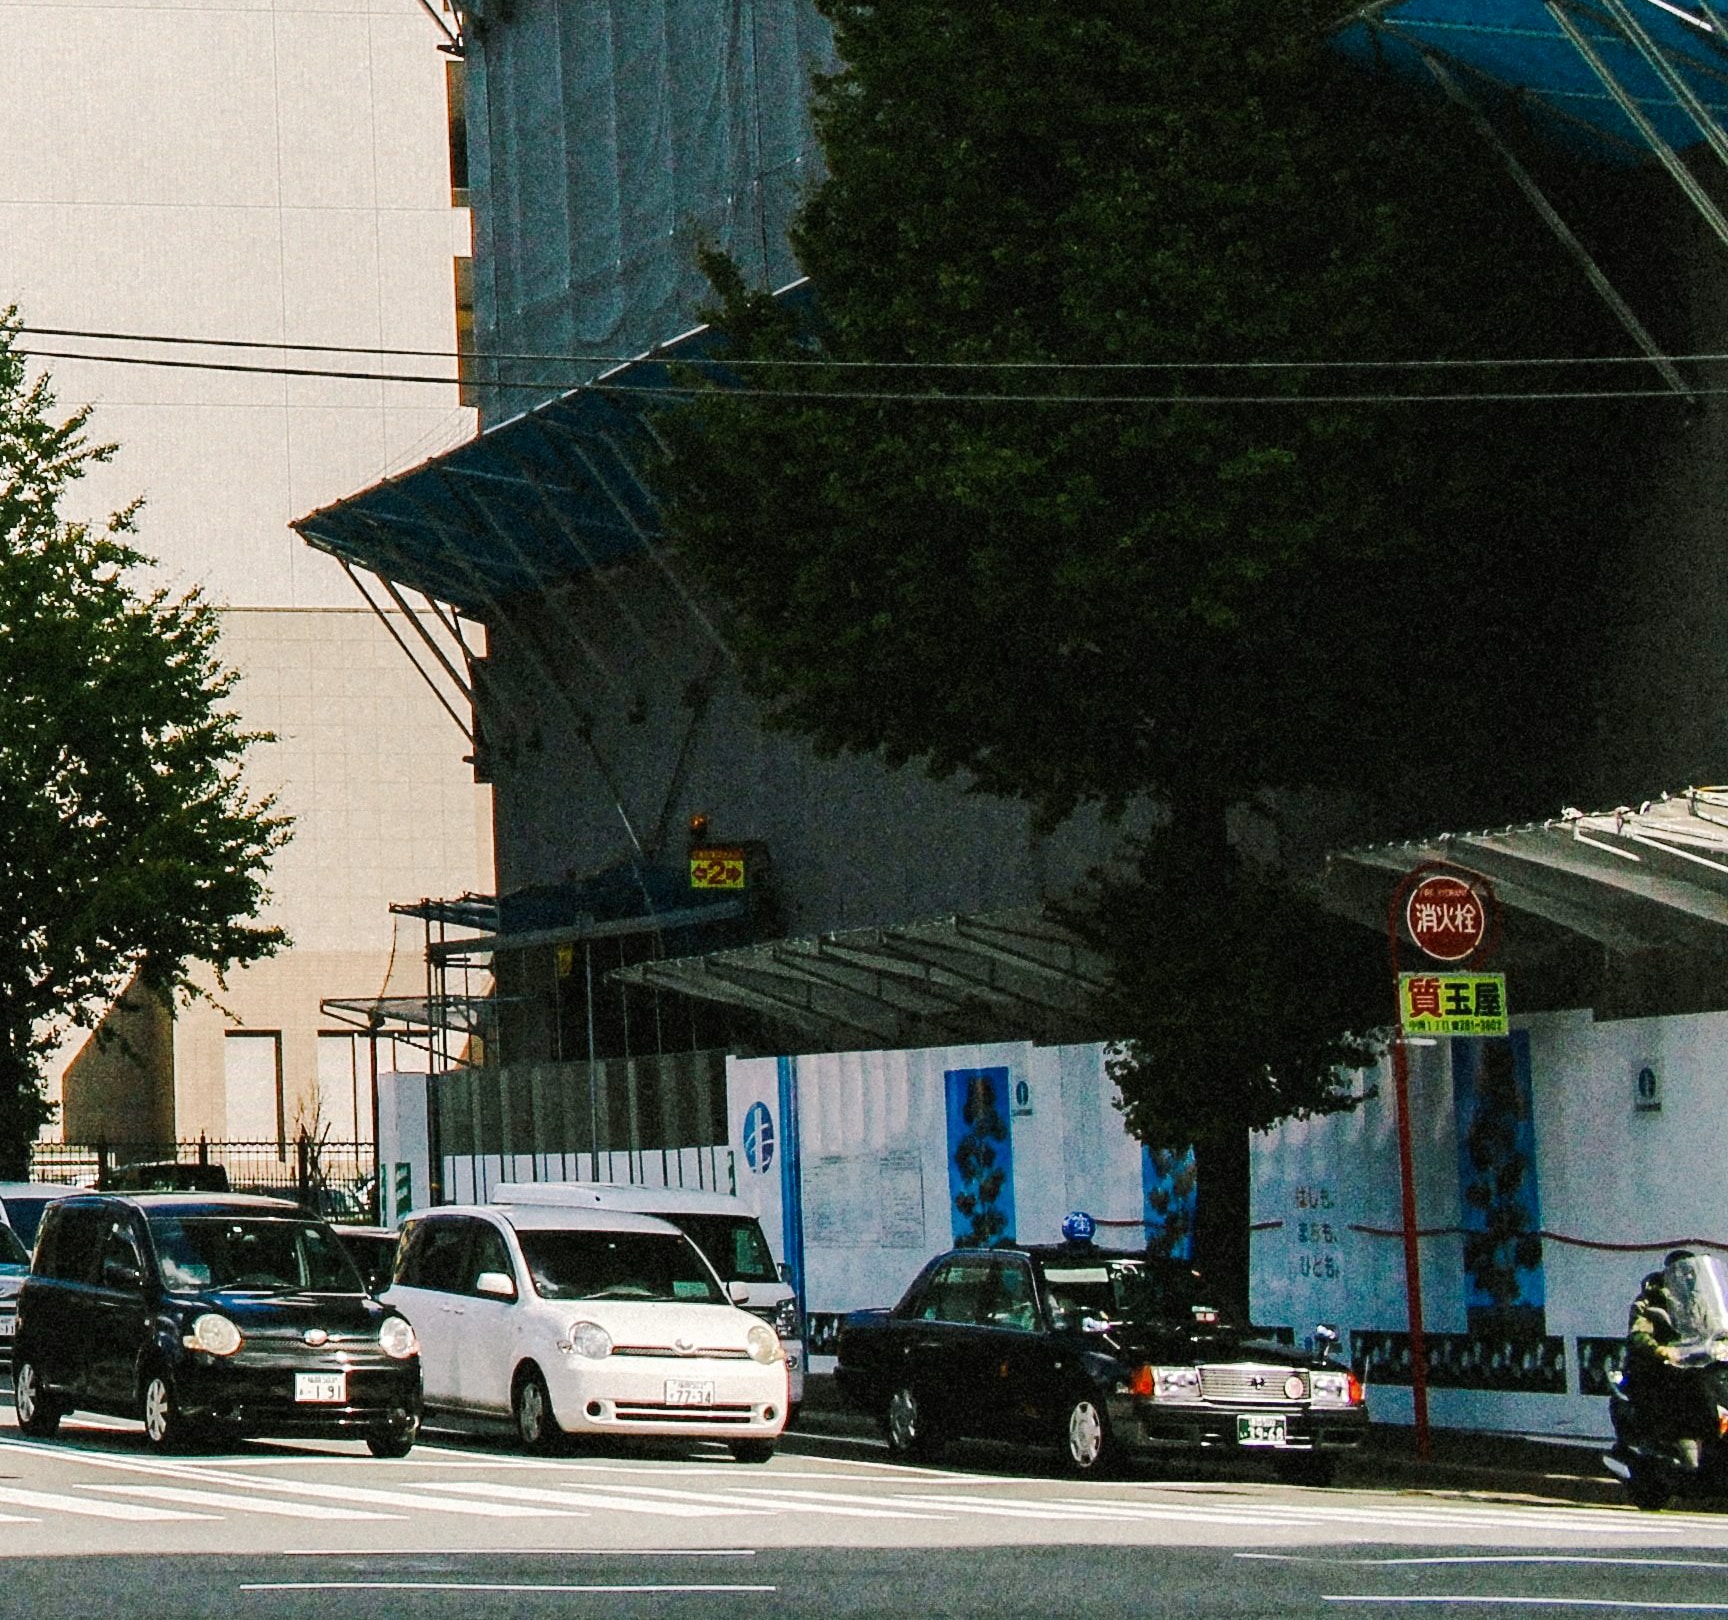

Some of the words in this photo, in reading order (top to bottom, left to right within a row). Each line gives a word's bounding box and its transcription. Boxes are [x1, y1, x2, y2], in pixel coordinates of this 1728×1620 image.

[1416, 903, 1476, 933] 消火栓
[1408, 978, 1502, 1018] 質玉屋
